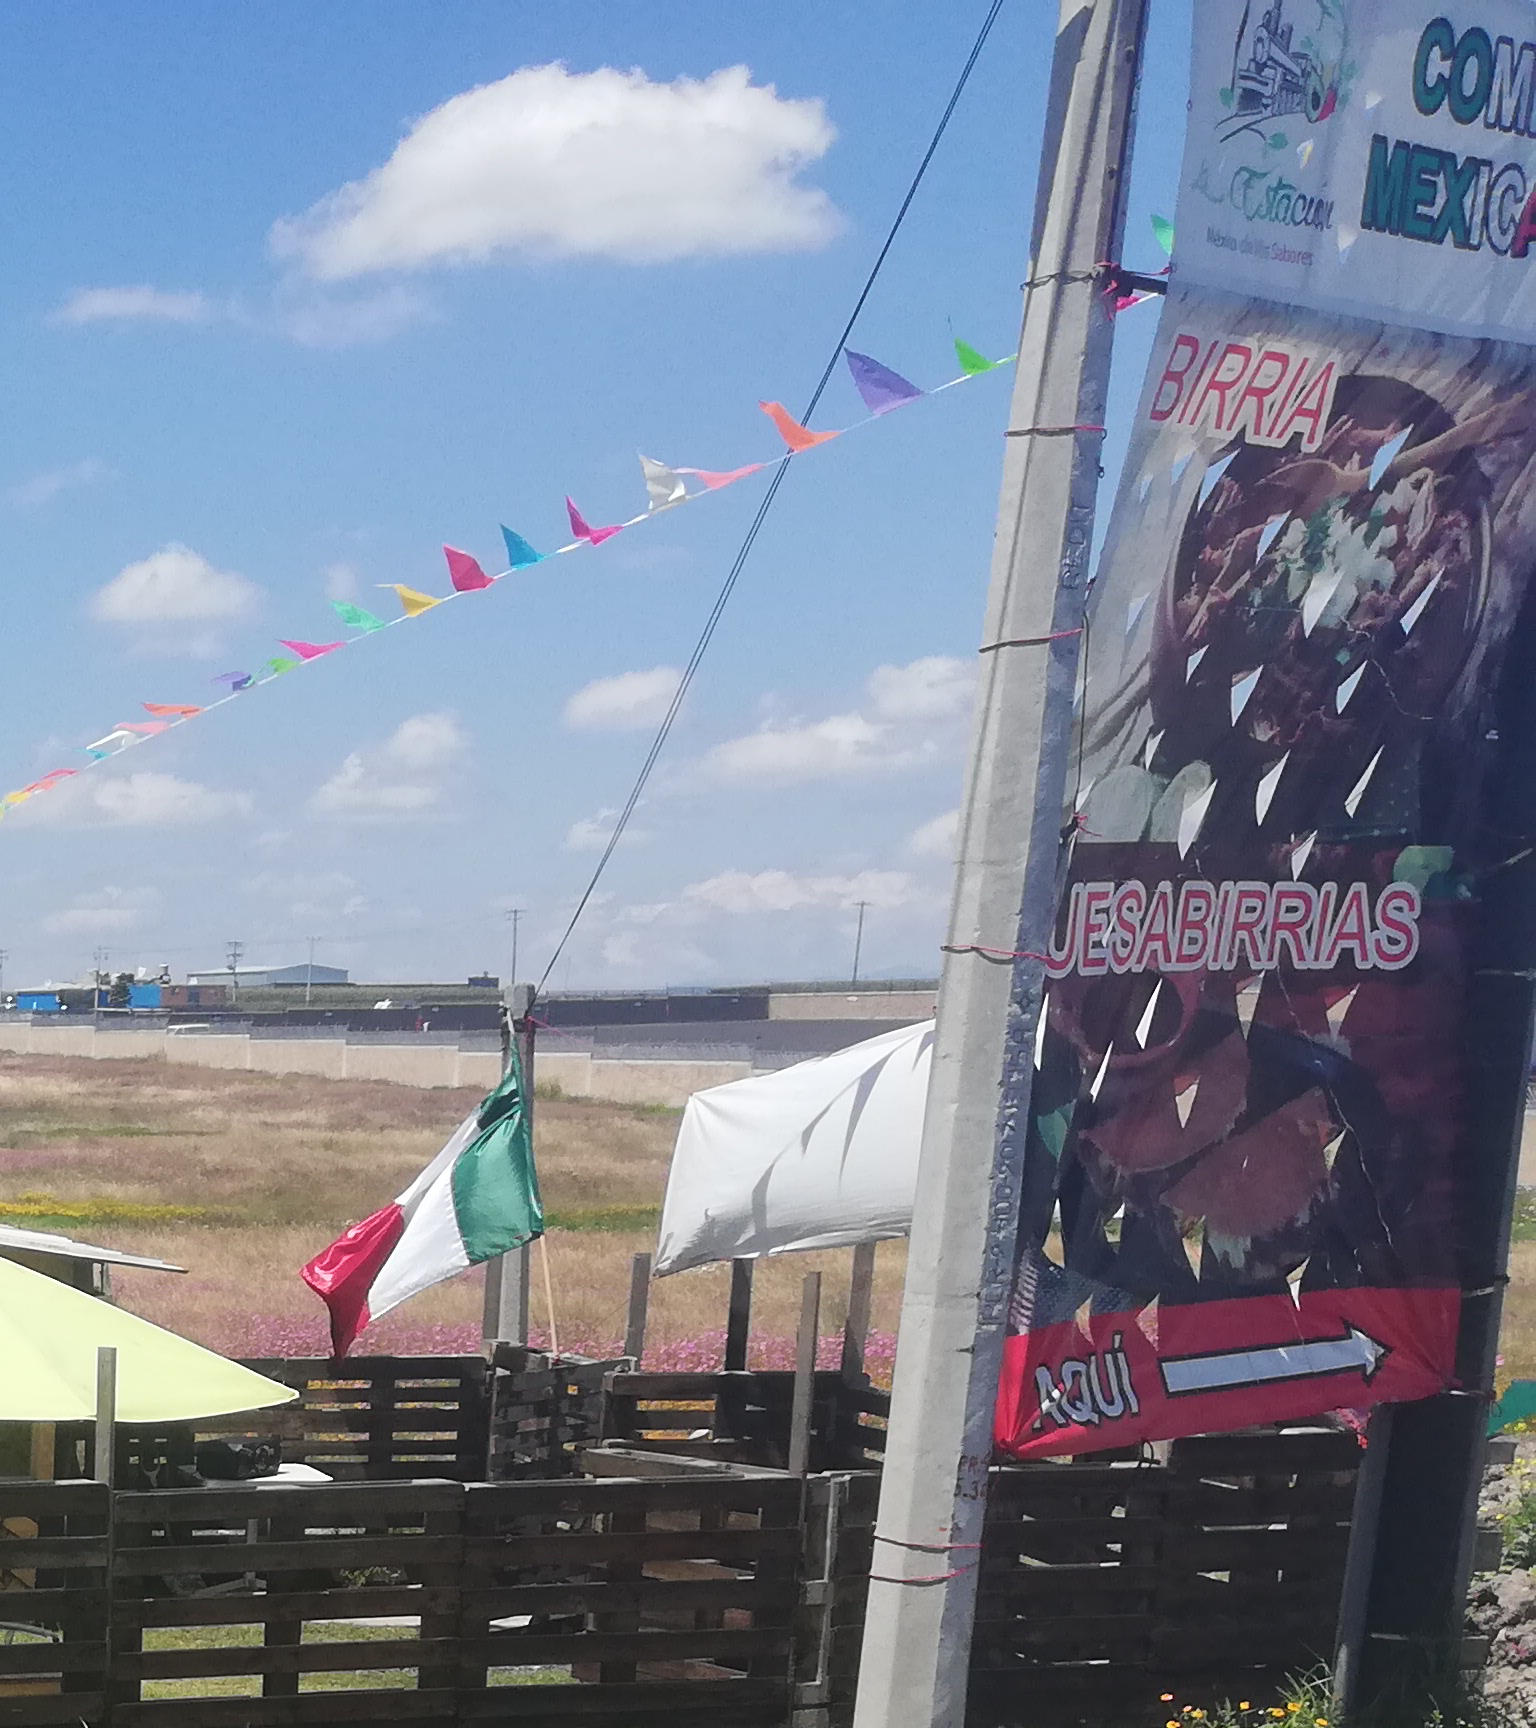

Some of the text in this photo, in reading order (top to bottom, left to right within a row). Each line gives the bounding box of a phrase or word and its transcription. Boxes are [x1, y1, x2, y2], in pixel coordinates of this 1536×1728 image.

[1411, 16, 1536, 138] COM
[1149, 333, 1336, 445] BIRRIA
[1031, 1329, 1140, 1433] AQUÍ
